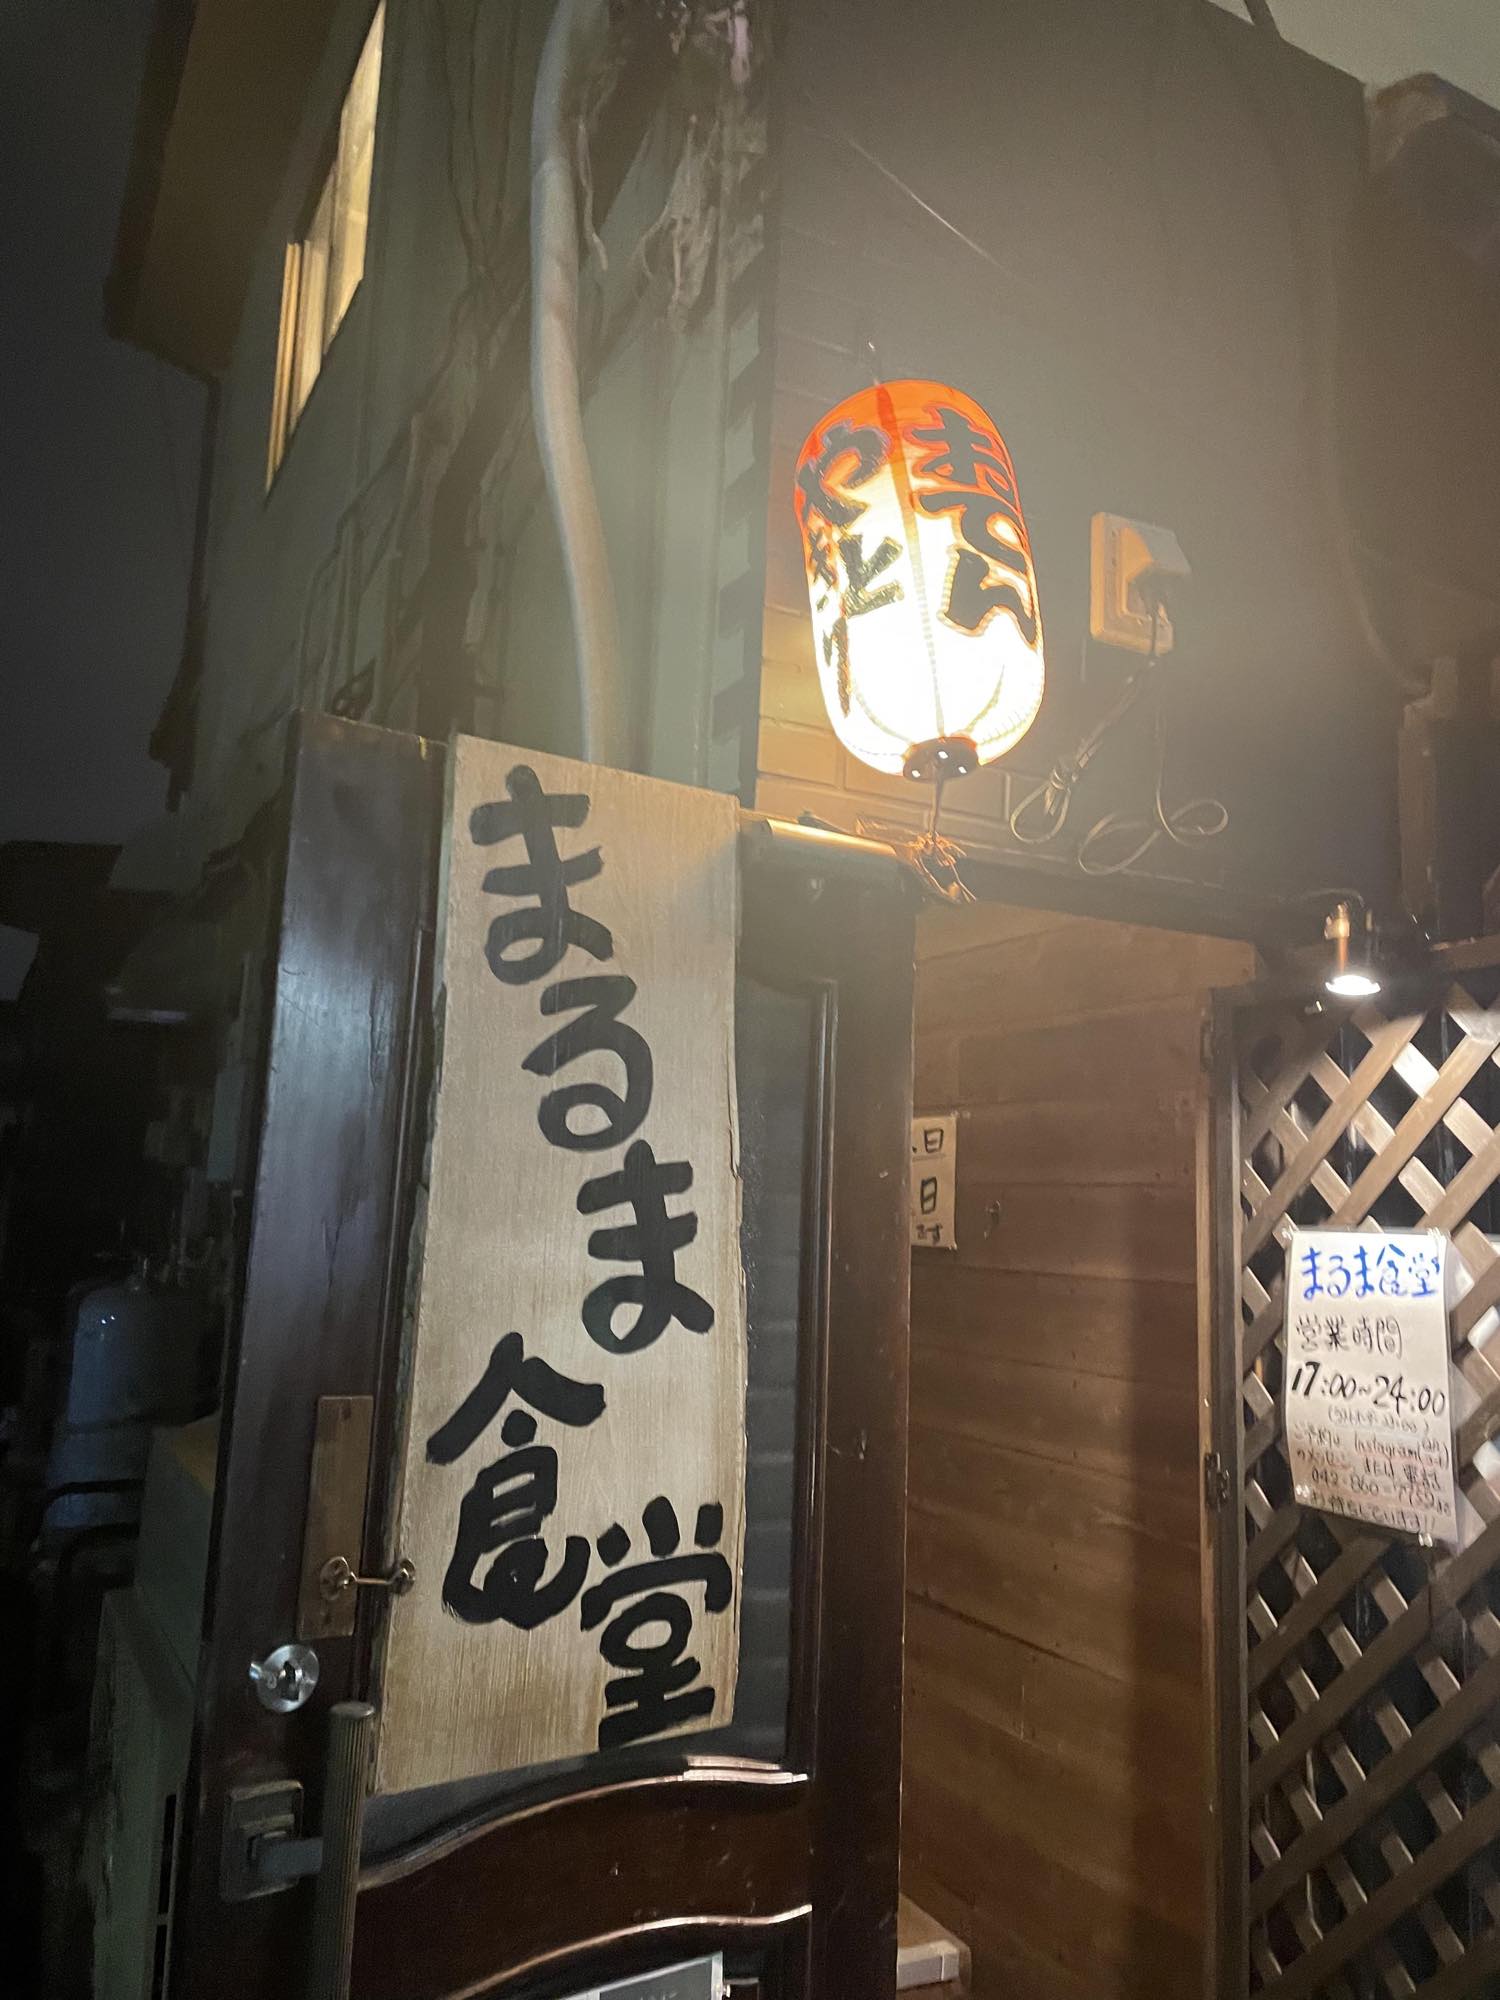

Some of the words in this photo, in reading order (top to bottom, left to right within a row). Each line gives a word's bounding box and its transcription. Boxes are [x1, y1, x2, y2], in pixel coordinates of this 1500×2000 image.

[426, 764, 732, 1750] まるま食堂
[1301, 1243, 1440, 1300] まるま食堂
[1296, 1313, 1403, 1360] 営業時間
